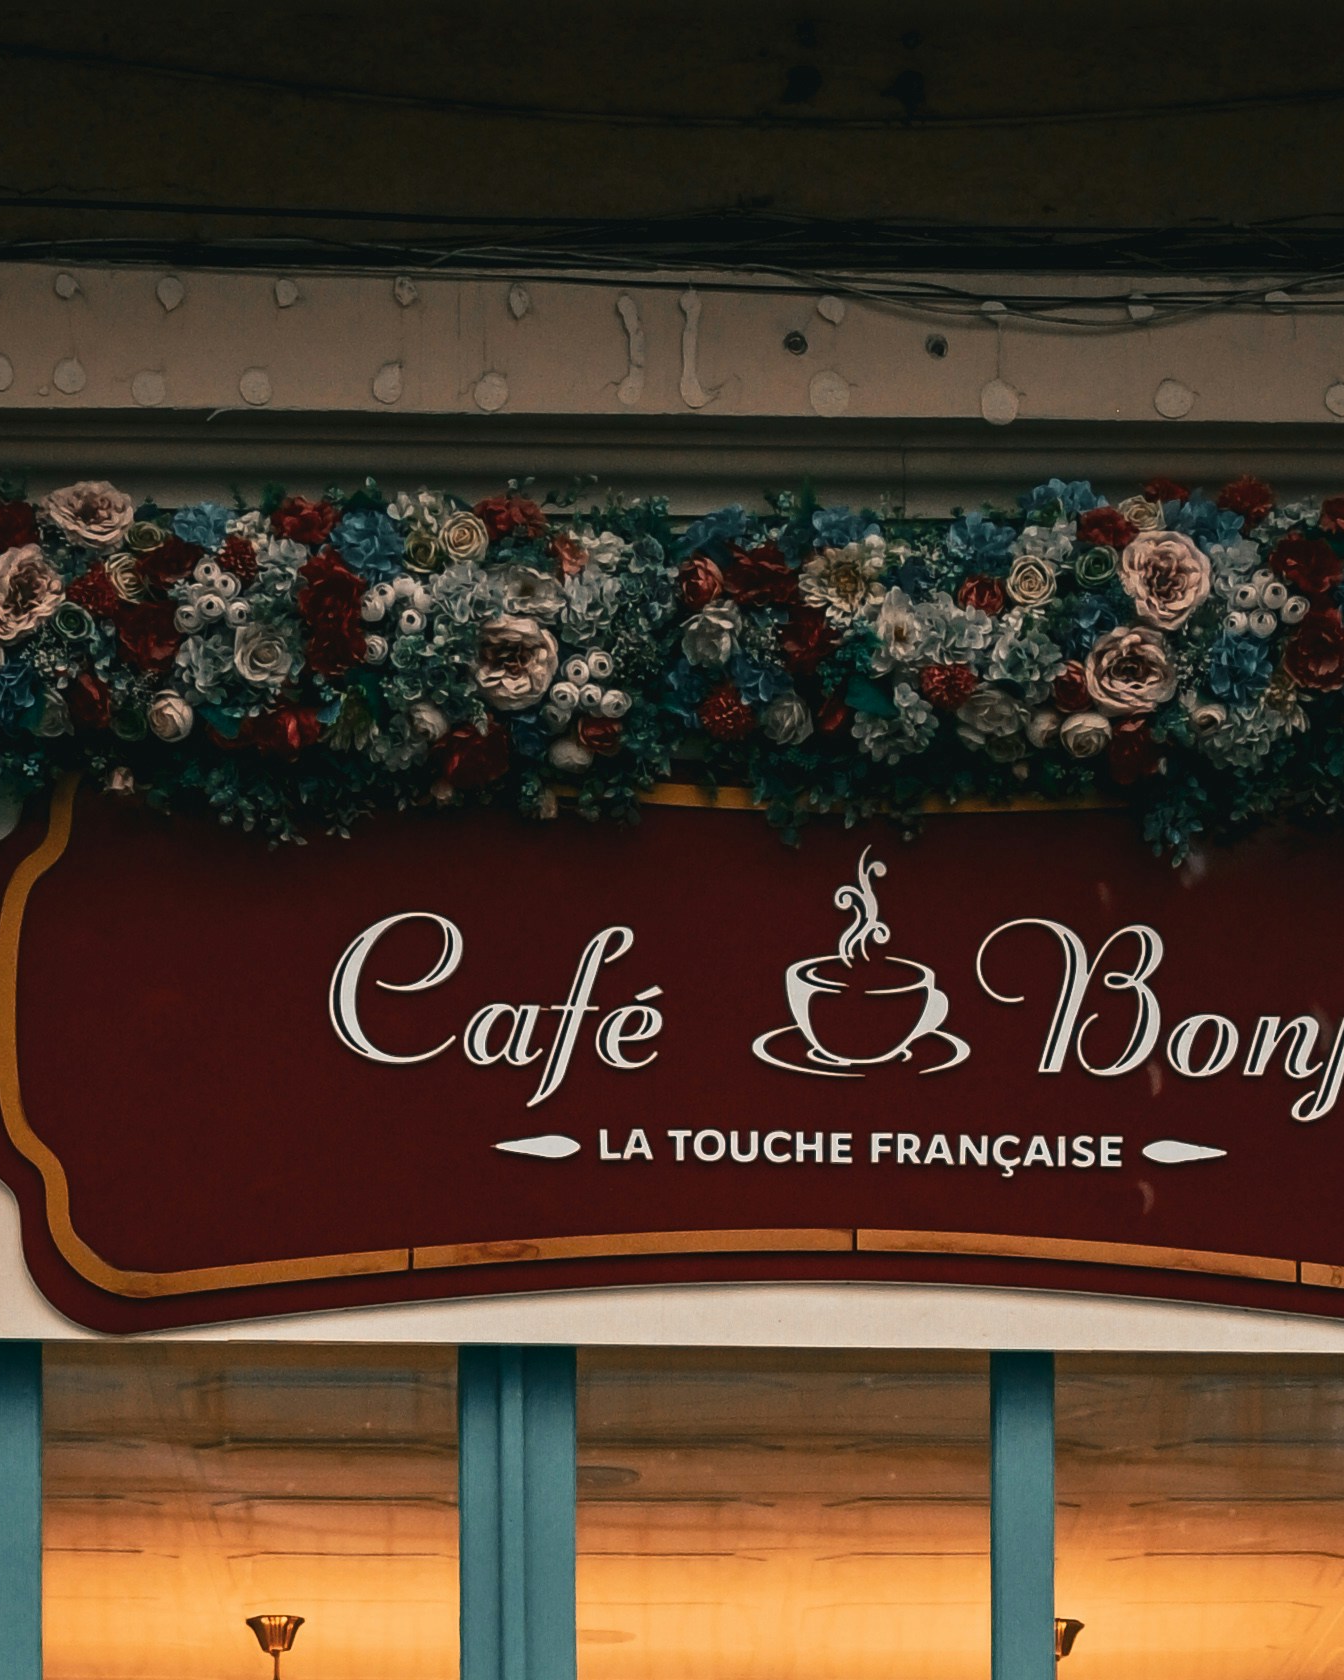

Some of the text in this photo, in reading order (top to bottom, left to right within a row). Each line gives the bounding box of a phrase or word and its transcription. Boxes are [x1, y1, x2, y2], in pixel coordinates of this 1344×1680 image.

[328, 912, 663, 1108] Café
[599, 1128, 1124, 1178] LA TOUCHE FRANÇAISE
